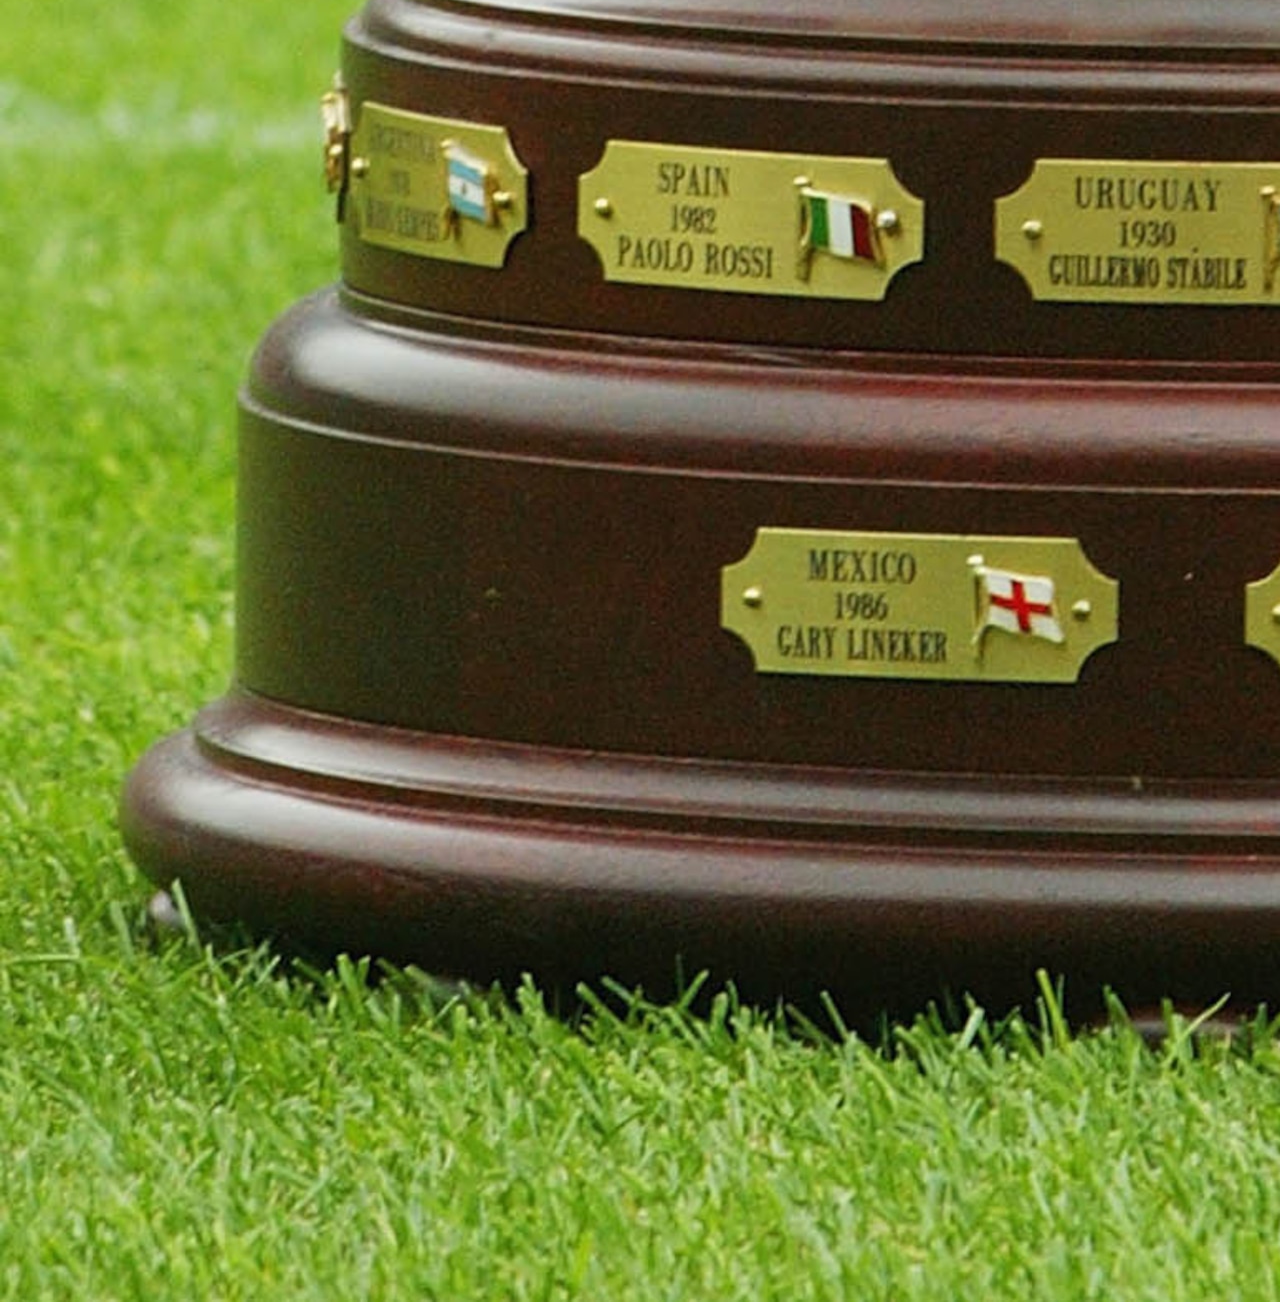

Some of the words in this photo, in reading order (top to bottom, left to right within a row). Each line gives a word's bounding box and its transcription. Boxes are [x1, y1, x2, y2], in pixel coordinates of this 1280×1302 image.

[657, 162, 730, 197] SPAIN
[1075, 176, 1221, 212] URUGUAY
[671, 204, 717, 234] 1982
[1119, 220, 1177, 247] 1930
[617, 235, 694, 272] PAOLO
[704, 242, 773, 279] ROSSI
[1049, 254, 1161, 288] GUILLERMO
[808, 549, 917, 584] MEXICO
[835, 591, 889, 621] 1986
[777, 624, 837, 660] GARY
[847, 628, 948, 664] LINEKER
